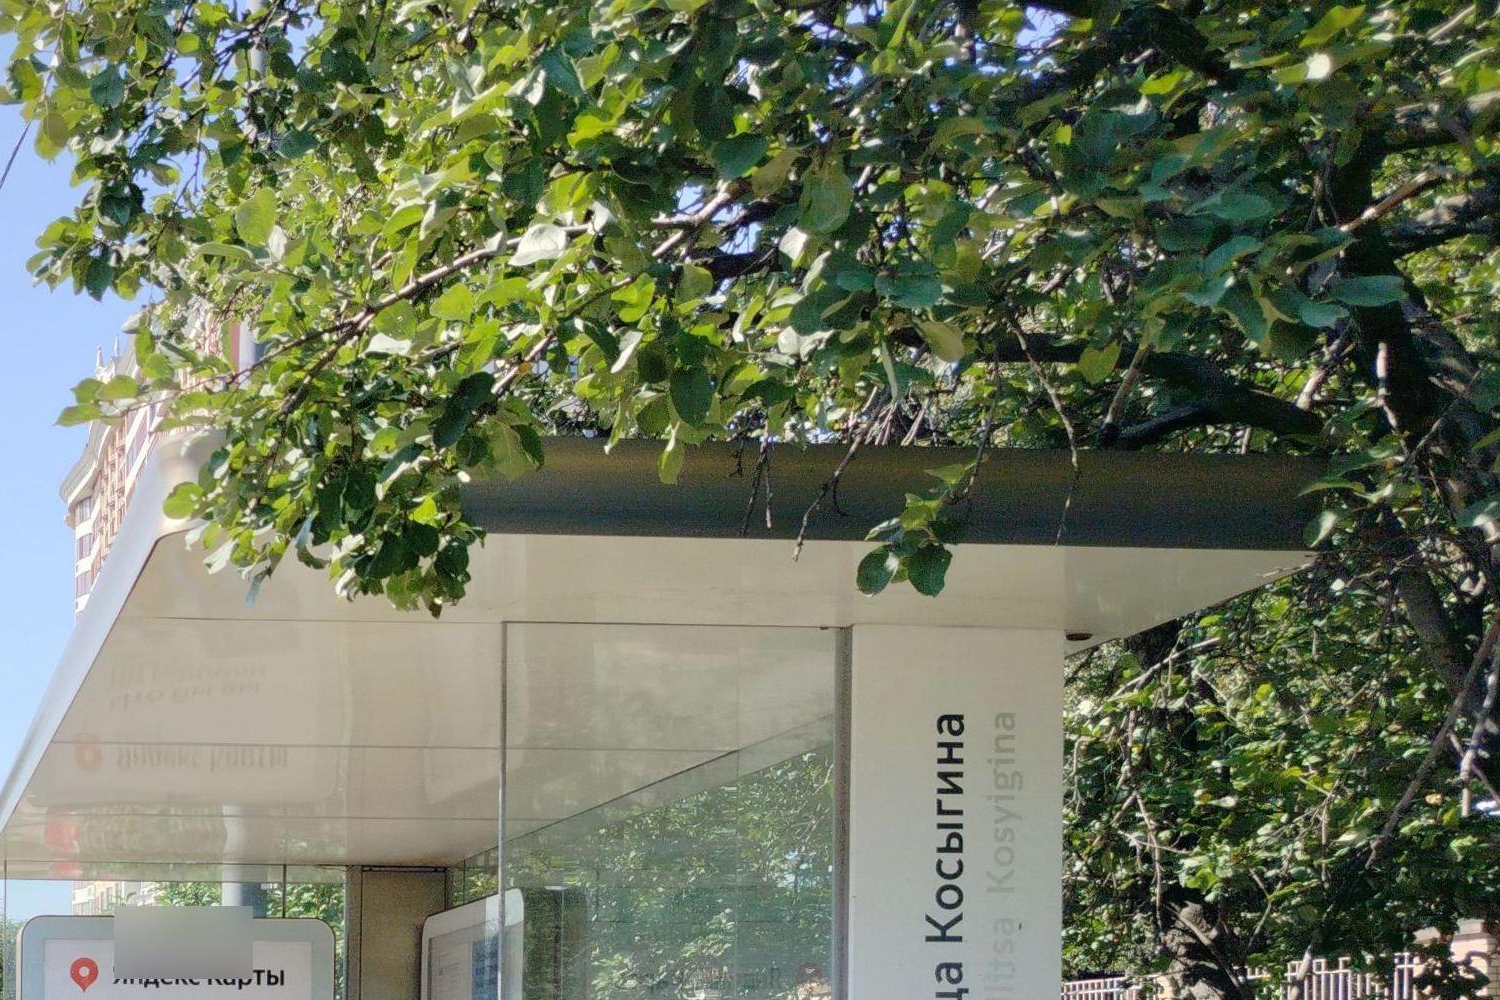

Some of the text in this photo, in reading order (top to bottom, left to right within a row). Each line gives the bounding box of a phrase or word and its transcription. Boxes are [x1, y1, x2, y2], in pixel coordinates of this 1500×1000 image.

[925, 713, 964, 943] Косыгина
[985, 711, 1023, 894] Kosyigina
[207, 967, 285, 990] рты
